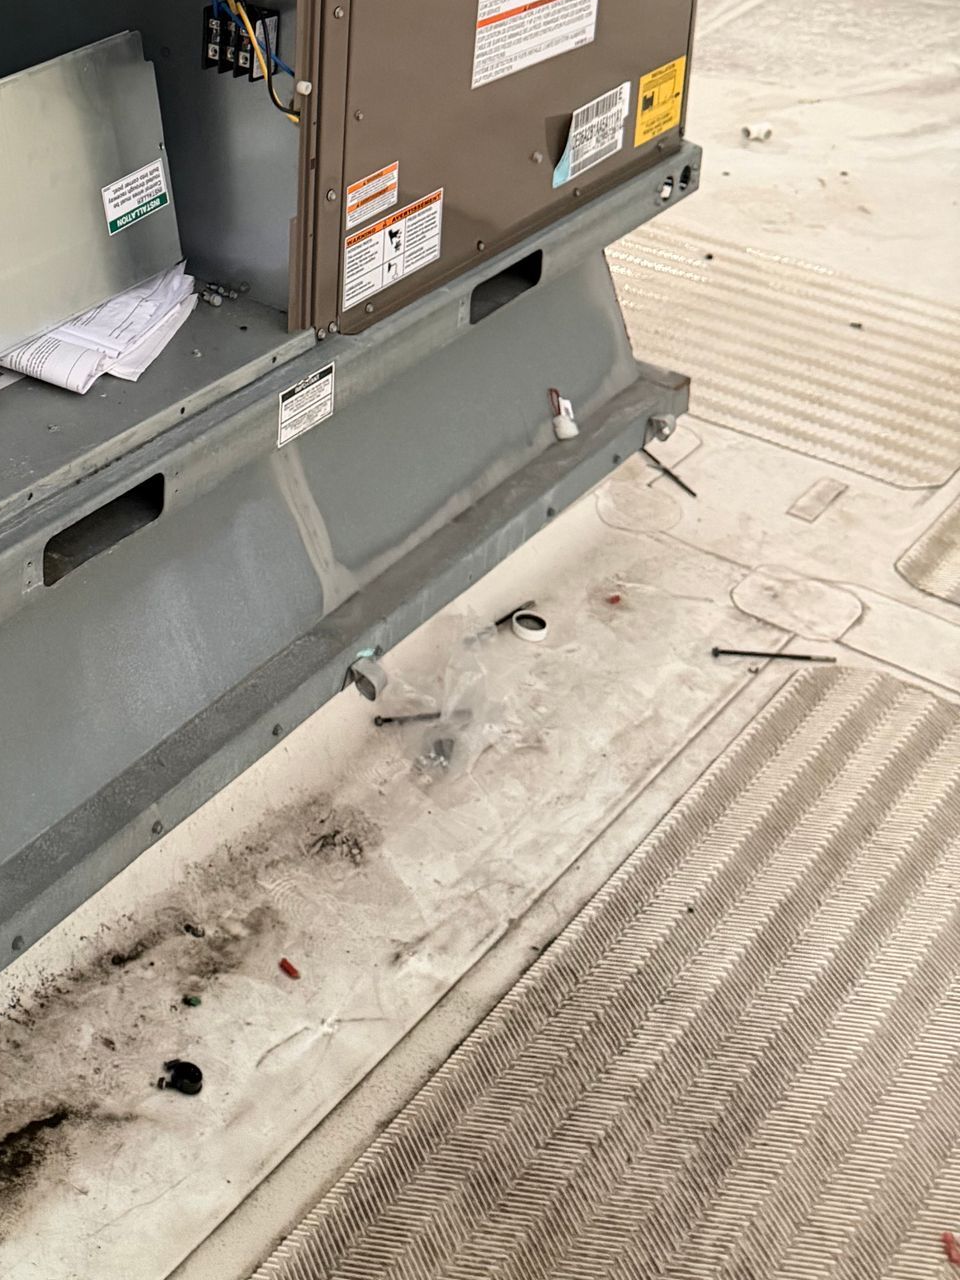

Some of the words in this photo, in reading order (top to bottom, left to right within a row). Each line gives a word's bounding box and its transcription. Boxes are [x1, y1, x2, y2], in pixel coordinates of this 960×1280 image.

[116, 197, 160, 227] INSTALLATION
[346, 227, 375, 247] WARNING
[392, 192, 440, 223] AVERTISSEMENT
